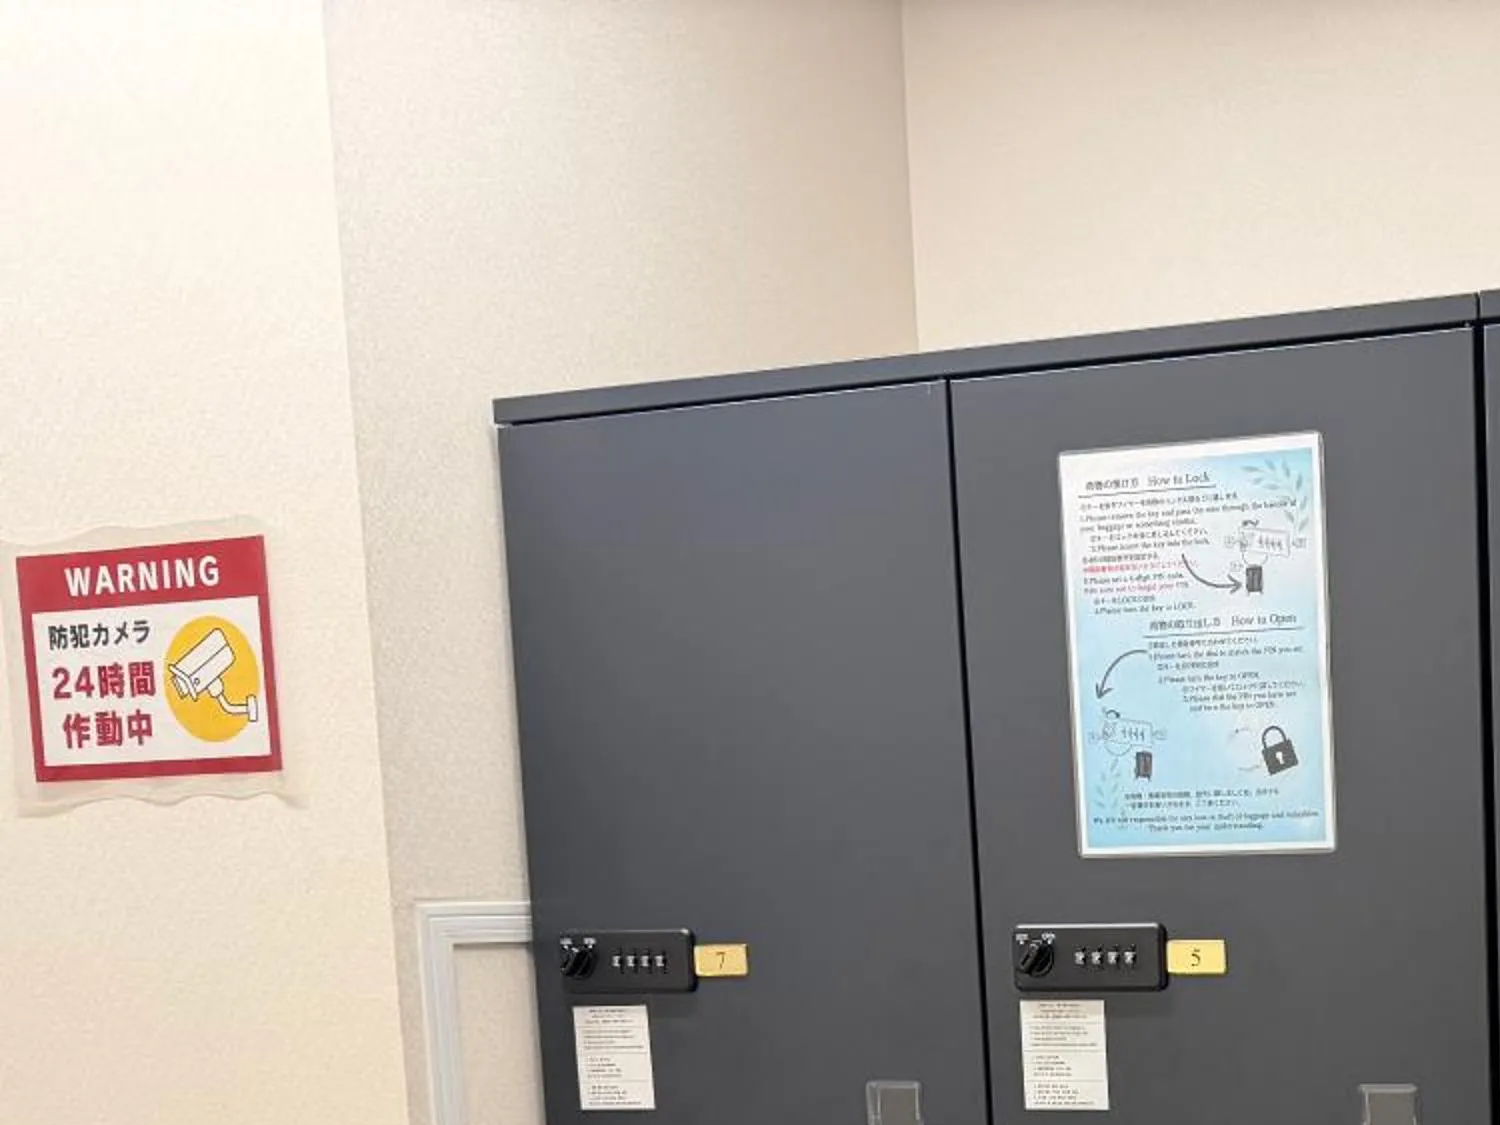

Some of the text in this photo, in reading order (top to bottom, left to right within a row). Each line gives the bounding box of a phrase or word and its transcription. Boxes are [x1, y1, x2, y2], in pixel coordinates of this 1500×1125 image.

[1185, 471, 1210, 484] Lock
[64, 555, 220, 597] WARNING
[48, 619, 151, 650] 防犯カメラ
[52, 661, 156, 700] 24時間
[62, 709, 153, 749] 作動中
[715, 951, 725, 969] 7
[1190, 948, 1201, 967] 5
